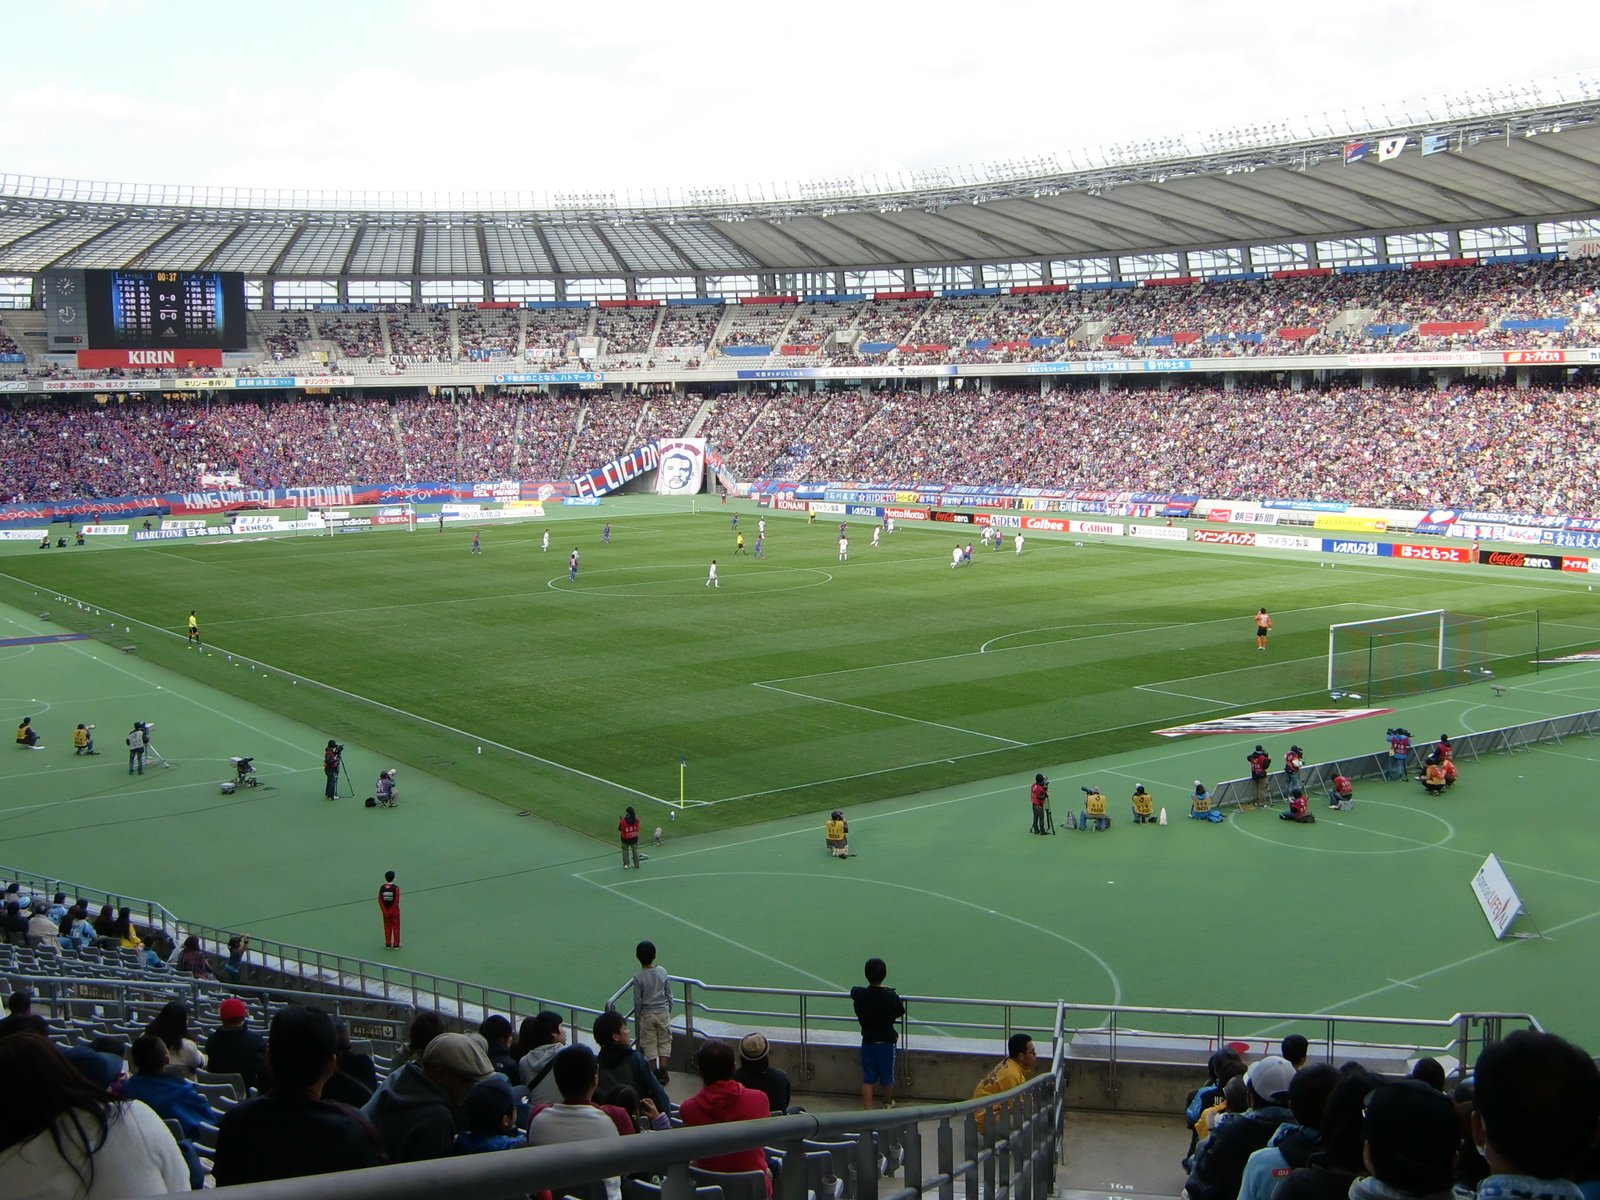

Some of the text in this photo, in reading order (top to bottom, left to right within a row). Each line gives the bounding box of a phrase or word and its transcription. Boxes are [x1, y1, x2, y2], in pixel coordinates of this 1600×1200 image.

[157, 272, 177, 281] 00:37
[128, 350, 175, 364] KIRIN
[574, 473, 608, 498] EL
[286, 486, 354, 508] STADIUM
[778, 501, 806, 510] KONAMI
[1026, 518, 1064, 531] Calbee
[1080, 522, 1113, 534] Canon
[136, 530, 184, 540] MARUTONE
[1555, 532, 1600, 549] 重松健太
[1401, 545, 1460, 561] ほっともっと
[1524, 557, 1552, 569] zero
